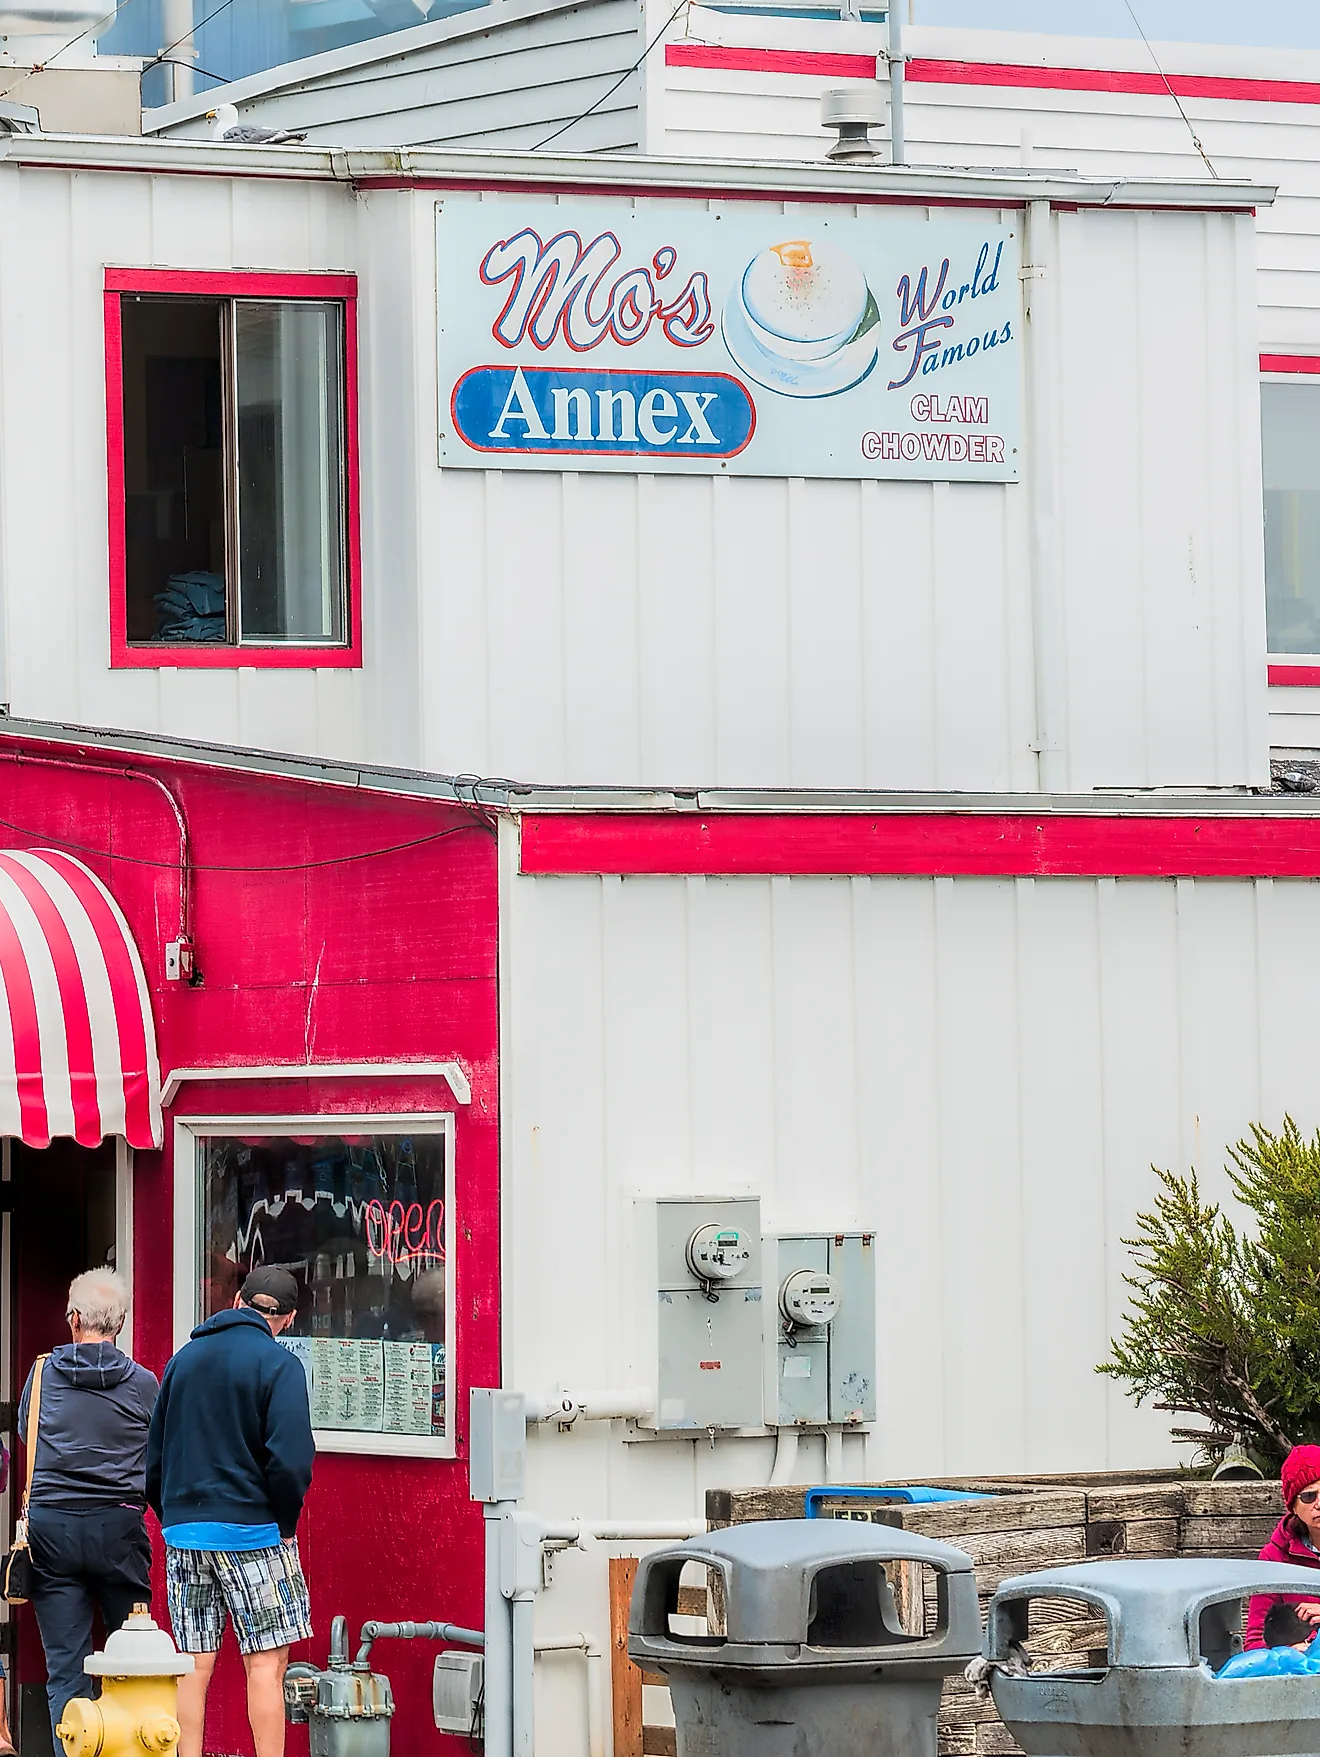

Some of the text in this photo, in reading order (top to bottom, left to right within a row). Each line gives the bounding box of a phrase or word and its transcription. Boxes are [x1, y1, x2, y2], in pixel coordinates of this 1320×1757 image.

[480, 227, 715, 353] Mo's
[896, 240, 1003, 327] World
[887, 315, 1013, 391] Famous
[488, 365, 721, 446] Annex
[910, 393, 989, 424] CLAM
[861, 431, 1005, 464] CHOWDER
